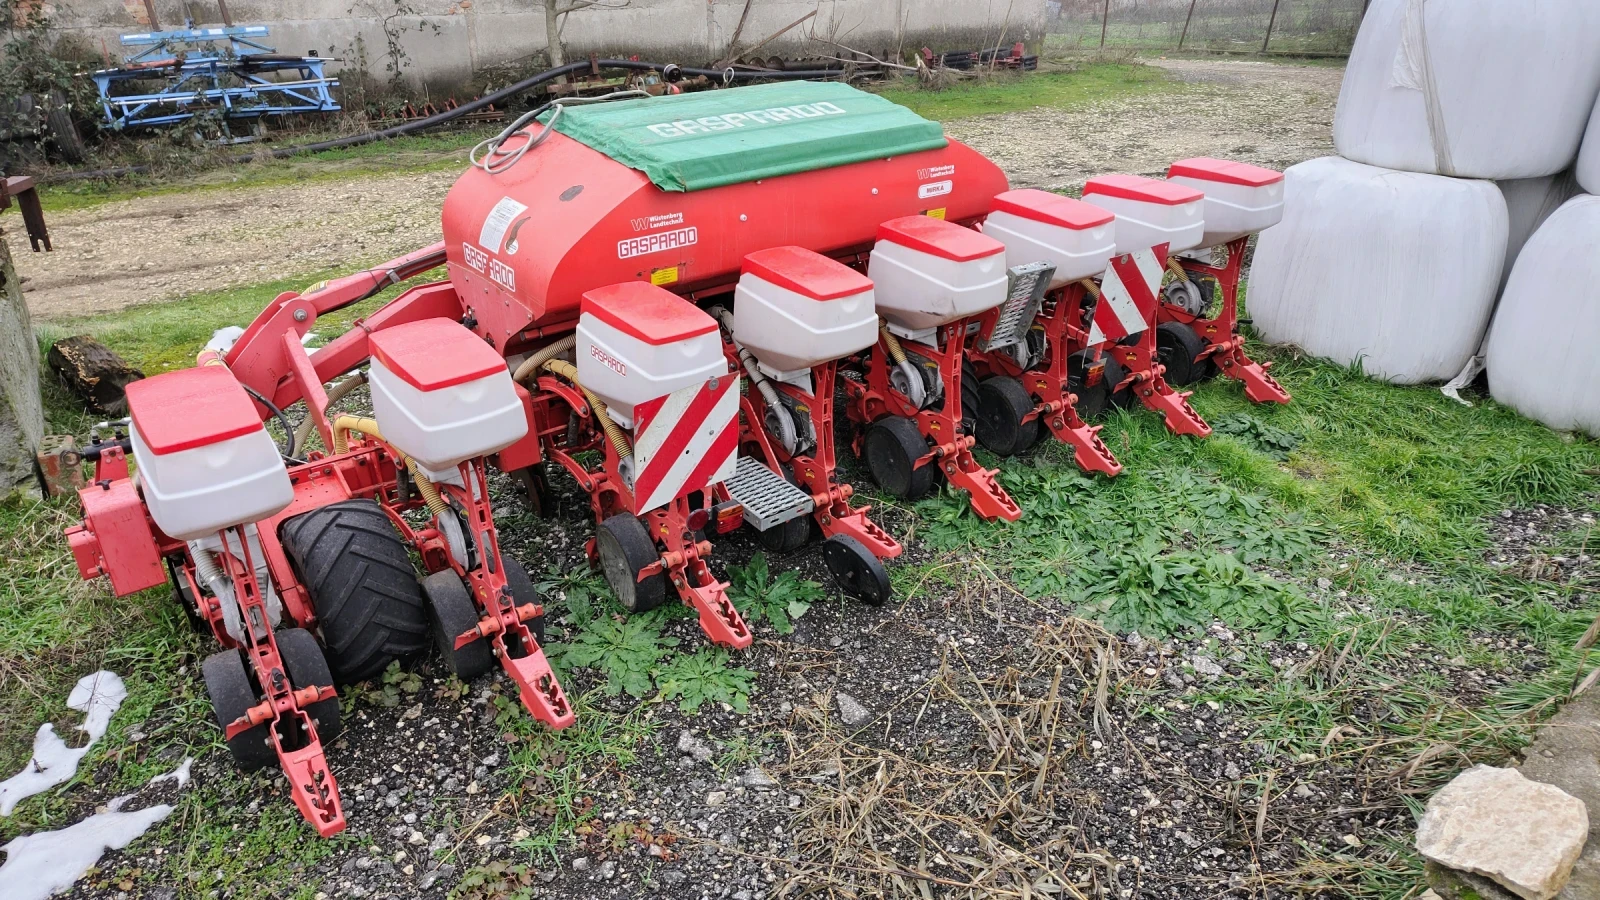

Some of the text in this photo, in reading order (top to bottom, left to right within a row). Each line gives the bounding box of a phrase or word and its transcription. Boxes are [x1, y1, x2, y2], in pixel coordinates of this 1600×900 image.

[646, 101, 847, 138] GASPARDO
[650, 212, 683, 222] Wüstenberg
[650, 218, 684, 229] Landtechnik
[618, 228, 697, 258] GASPARDO
